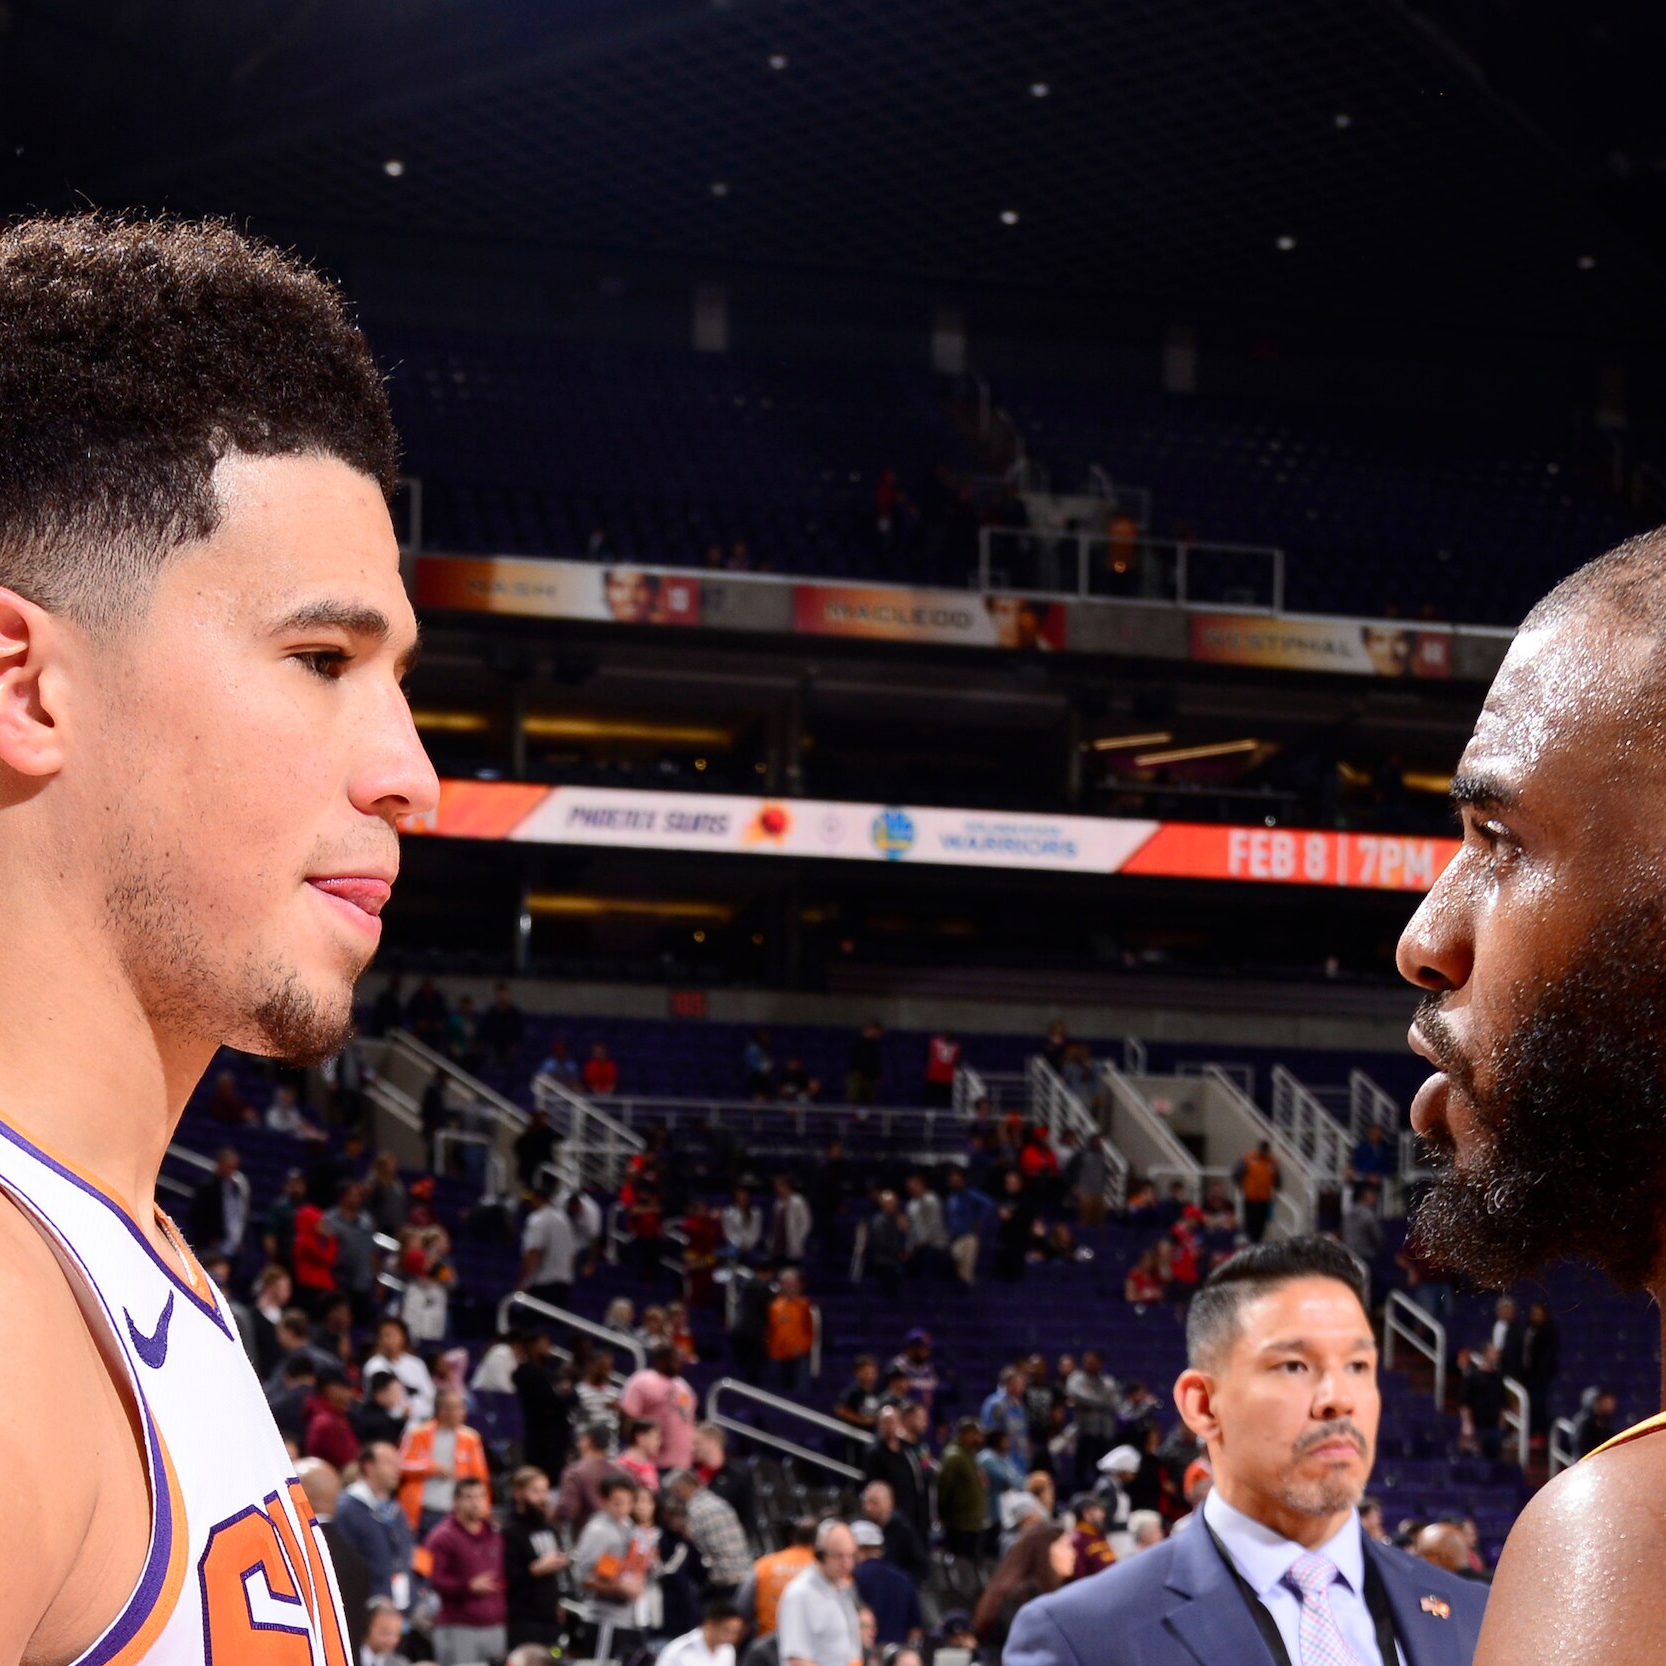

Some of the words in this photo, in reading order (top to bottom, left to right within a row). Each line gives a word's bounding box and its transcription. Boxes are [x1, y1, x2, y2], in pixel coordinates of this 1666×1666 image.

[938, 832, 1079, 860] WARRIORS
[1228, 828, 1295, 879] FEB
[1304, 832, 1327, 882] 8
[1357, 837, 1435, 888] 7PM
